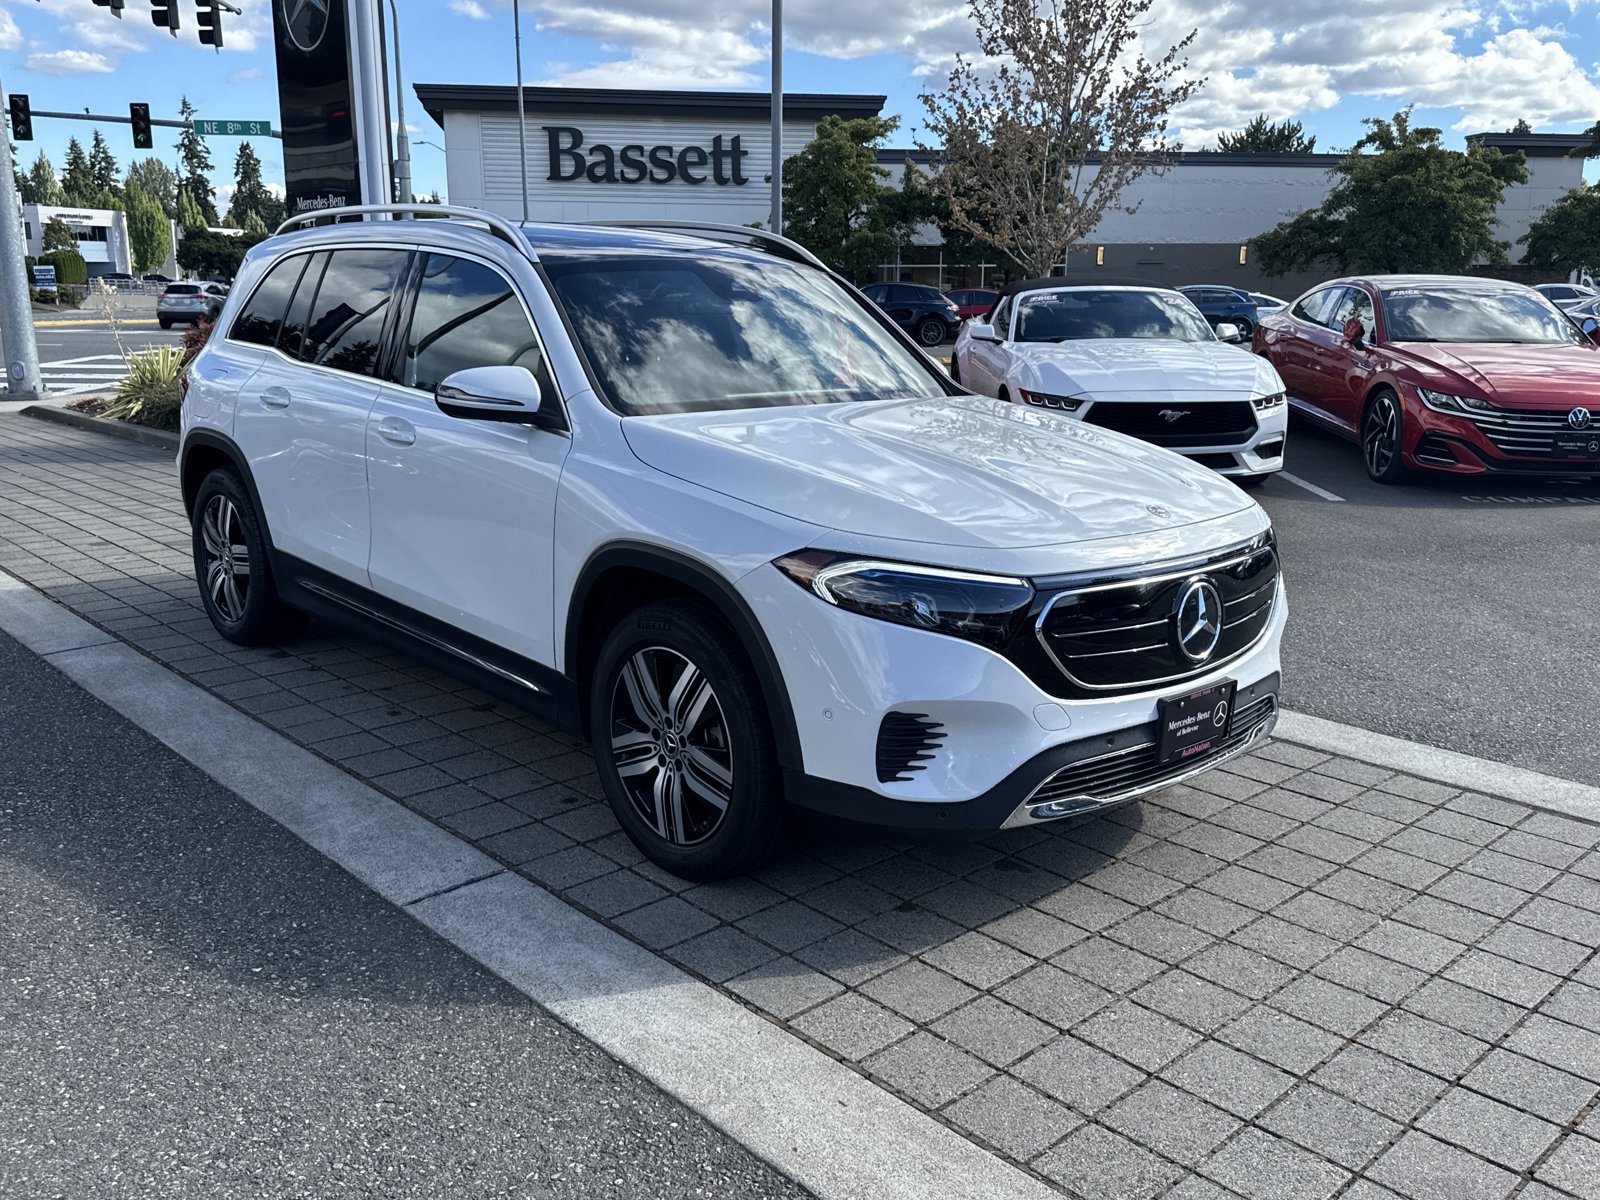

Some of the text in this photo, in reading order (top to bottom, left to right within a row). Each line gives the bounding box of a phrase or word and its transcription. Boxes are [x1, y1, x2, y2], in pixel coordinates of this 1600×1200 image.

[203, 121, 262, 135] NE 8th St
[541, 126, 749, 186] Bassett
[296, 193, 346, 211] Mercedes-Benz
[1168, 711, 1211, 732] Mercedes-Benz
[1181, 741, 1211, 758] AutoNation
